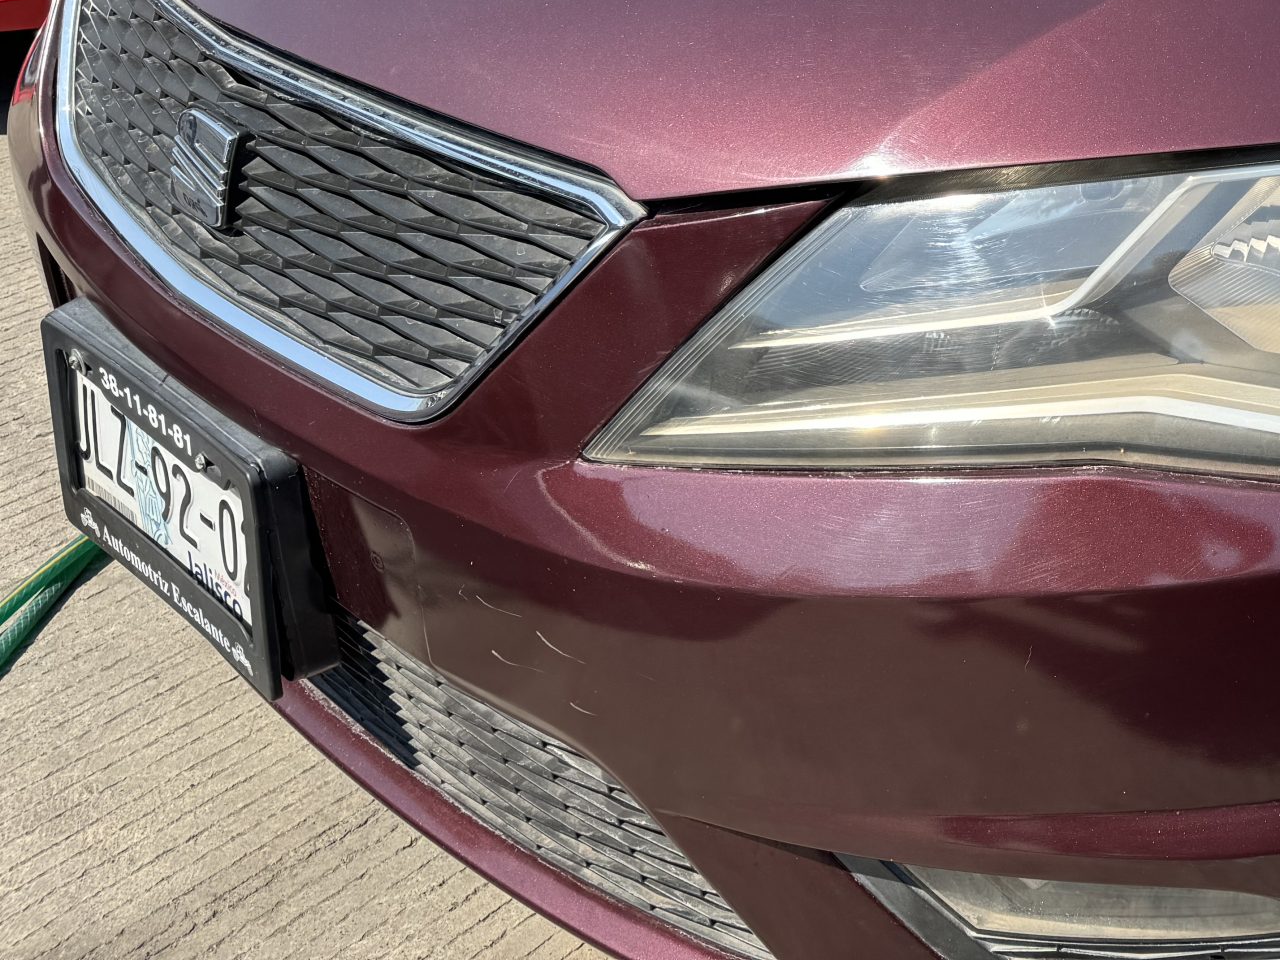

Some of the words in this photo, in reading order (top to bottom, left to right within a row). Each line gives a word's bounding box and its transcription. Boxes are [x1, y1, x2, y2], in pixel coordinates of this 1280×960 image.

[100, 368, 192, 456] 38-11-81-81
[79, 382, 247, 594] JLZ-92-0
[102, 525, 170, 596] Automotriz
[170, 582, 231, 652] Escalante
[187, 550, 243, 622] Jalisco
